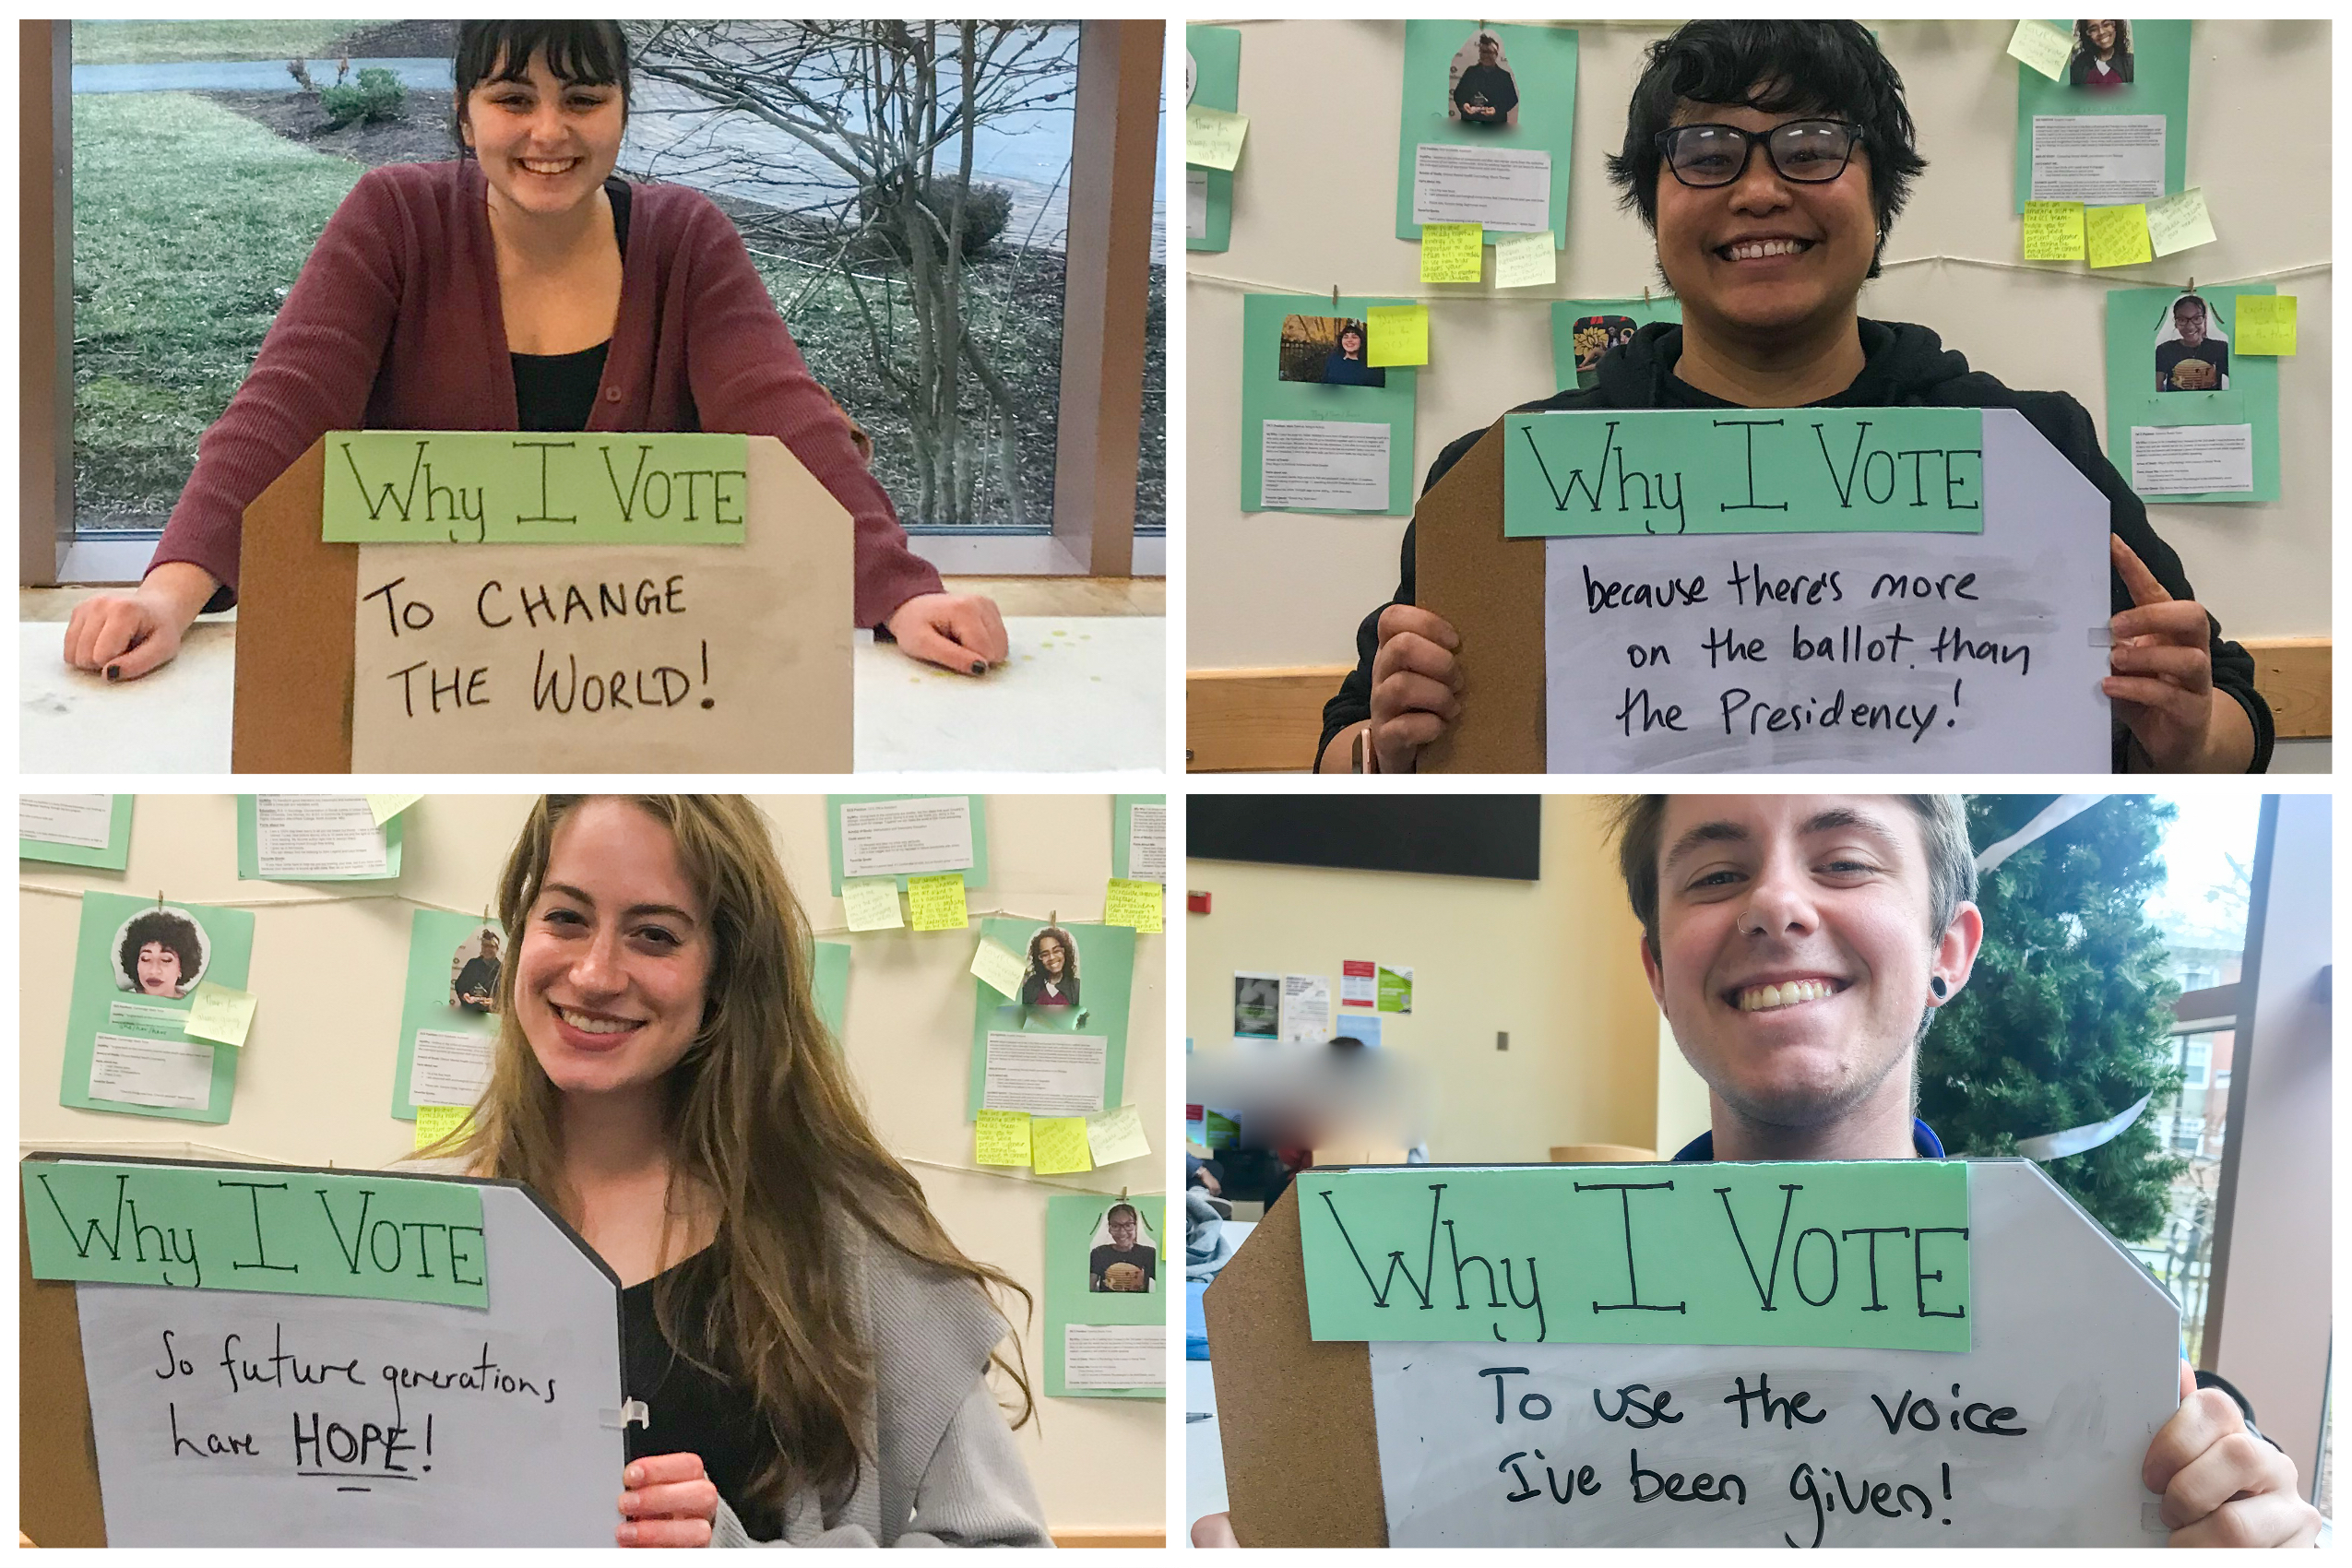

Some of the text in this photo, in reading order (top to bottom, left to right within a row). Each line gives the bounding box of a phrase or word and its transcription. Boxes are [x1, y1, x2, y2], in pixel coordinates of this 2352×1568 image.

[340, 440, 486, 543] Why
[513, 441, 576, 525] I
[1521, 422, 1686, 534] Why
[1713, 420, 1788, 512] I
[477, 575, 687, 628] CHANGE
[1583, 561, 1979, 613] because there's more
[387, 638, 716, 718] THE WORLD!
[1627, 644, 1670, 668] on
[1701, 626, 1767, 669] the
[1930, 626, 2030, 675] than
[1616, 677, 1962, 743] the Presidency!
[37, 1173, 202, 1288] Why
[218, 1180, 299, 1274] I
[1319, 1183, 1547, 1343] Why
[1574, 1181, 1687, 1315] I
[155, 1322, 556, 1432] So future generations
[1478, 1365, 2028, 1437] To use the voice
[169, 1402, 434, 1474] have HOPE!
[1498, 1447, 1954, 1548] I've been given!
